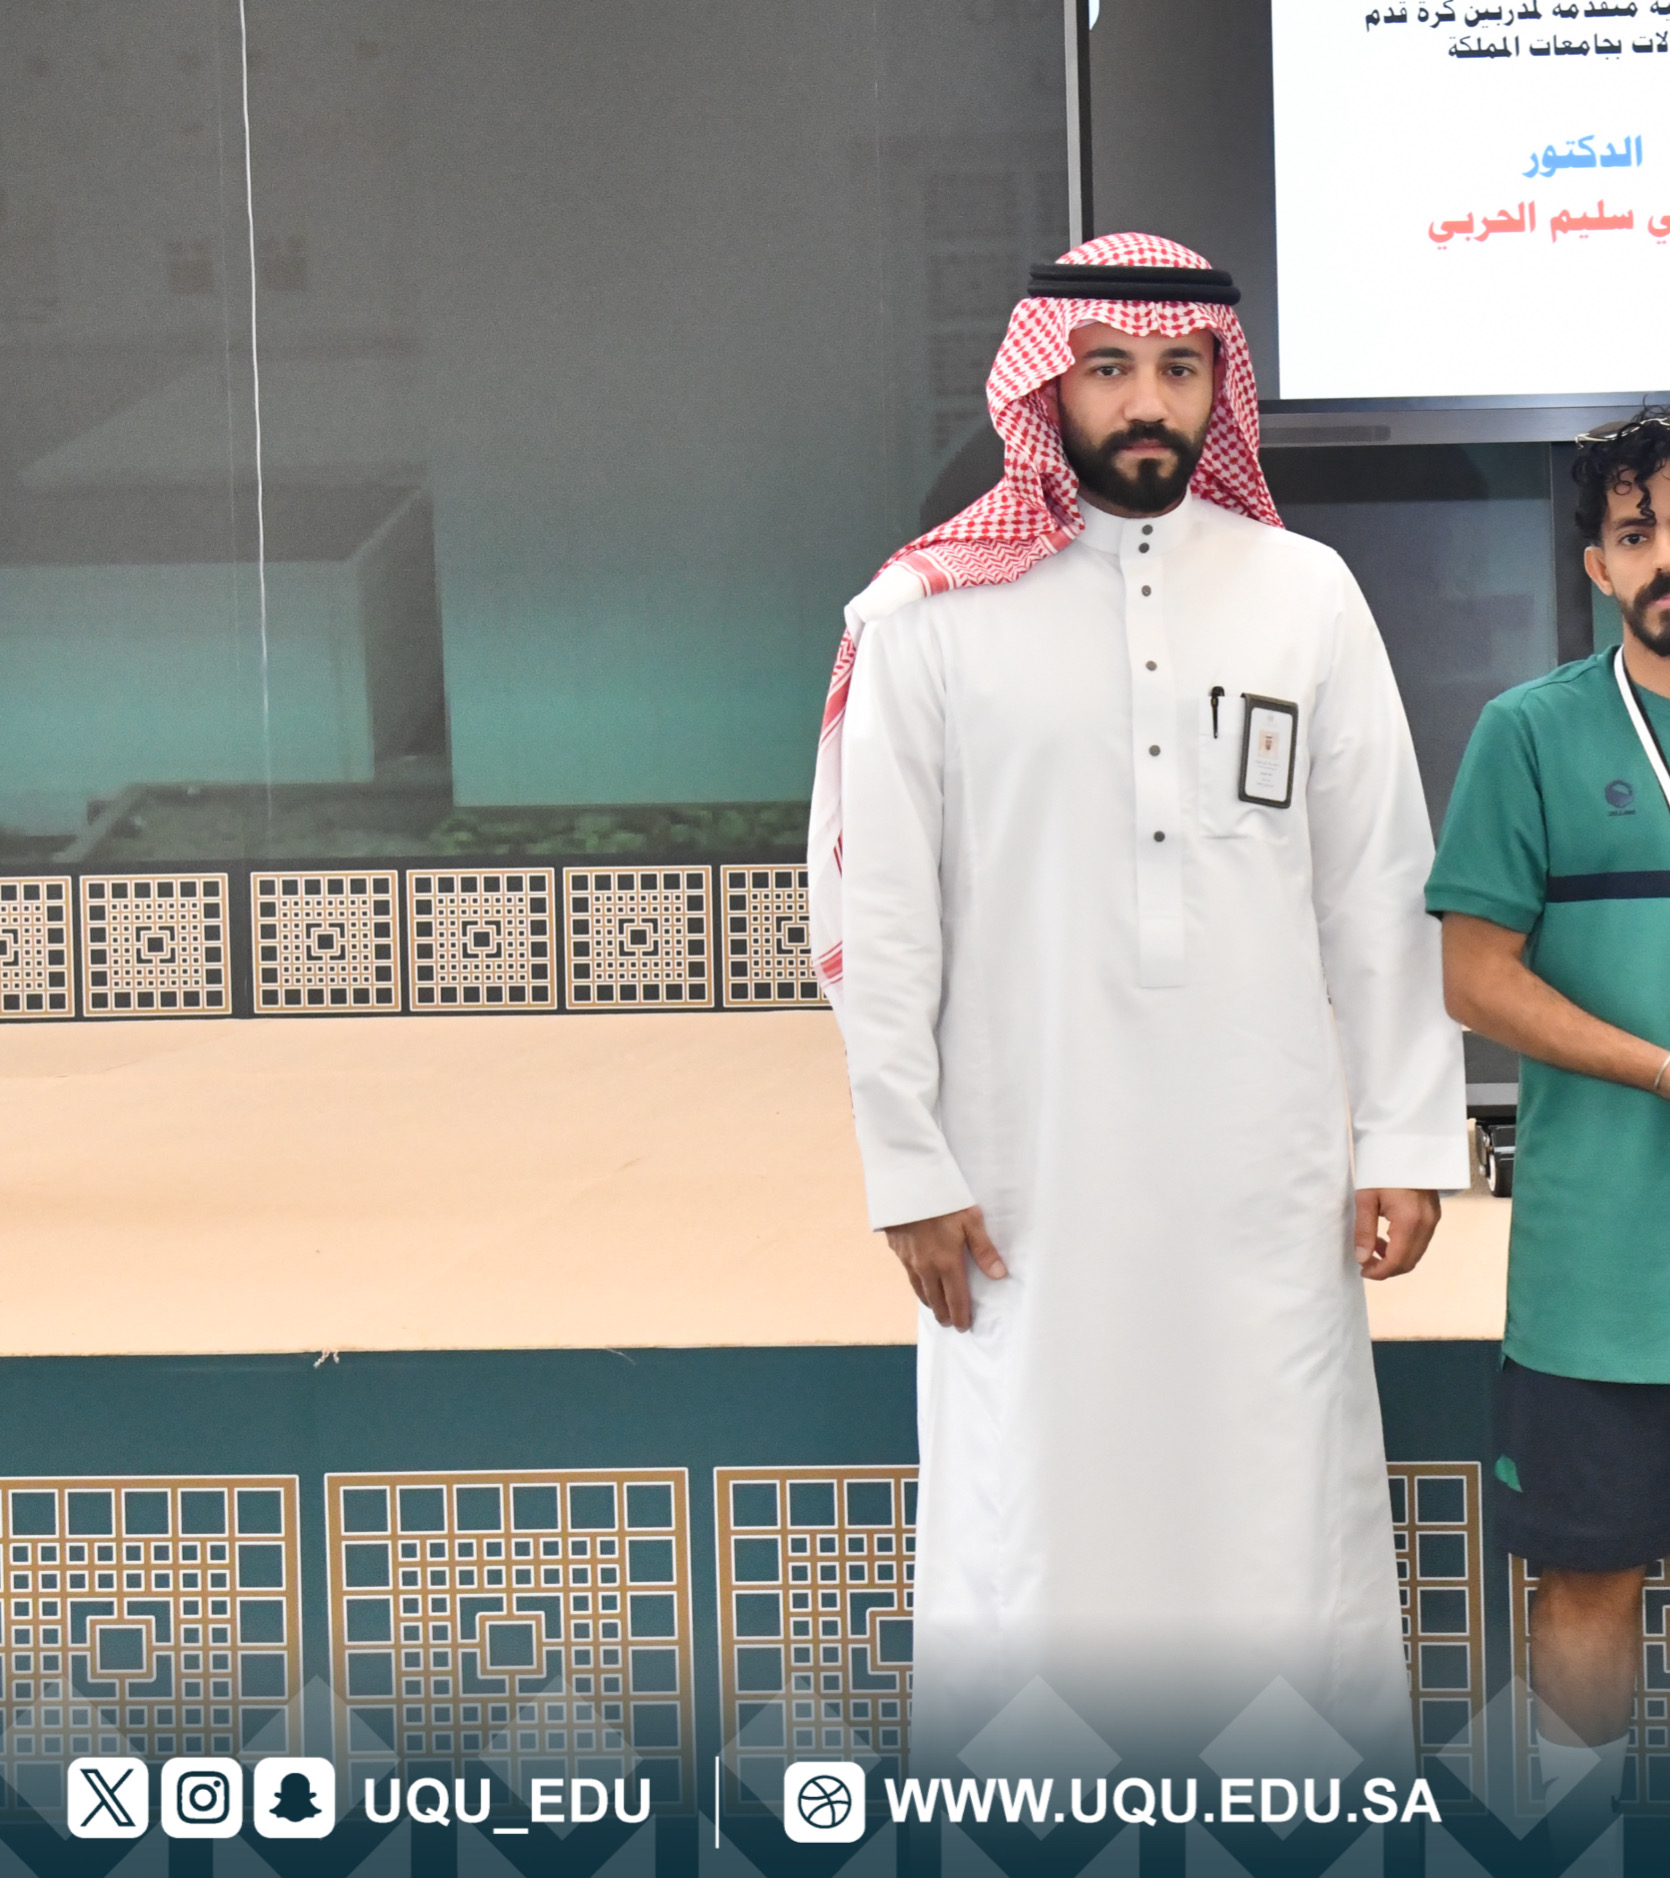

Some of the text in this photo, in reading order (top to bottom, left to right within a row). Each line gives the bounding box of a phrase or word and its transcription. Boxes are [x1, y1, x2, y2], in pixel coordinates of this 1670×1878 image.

[1365, 1, 1408, 32] قدم
[1417, 0, 1456, 28] كرة
[1448, 35, 1520, 59] المملكة
[1529, 33, 1622, 60] بجامعات
[1522, 135, 1643, 178] الدكتور
[1427, 201, 1537, 250] الحربي
[1550, 200, 1634, 243] سليم
